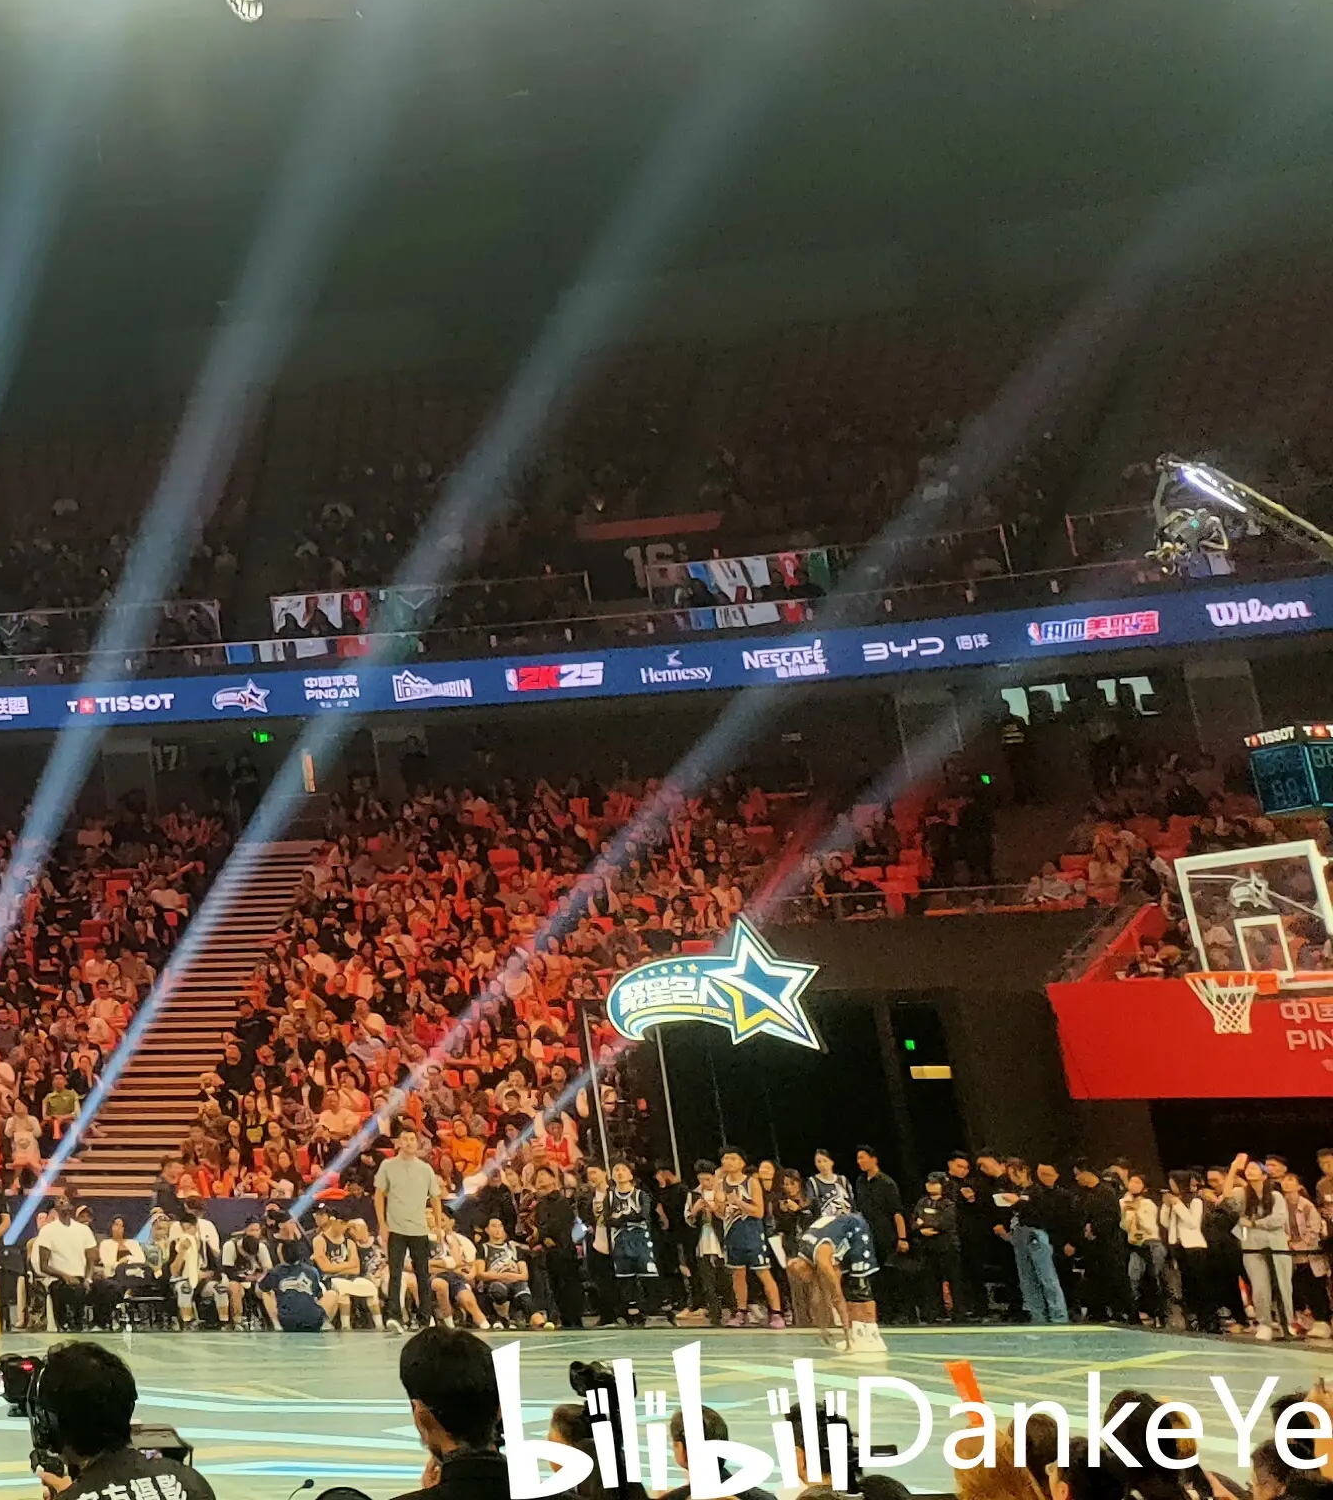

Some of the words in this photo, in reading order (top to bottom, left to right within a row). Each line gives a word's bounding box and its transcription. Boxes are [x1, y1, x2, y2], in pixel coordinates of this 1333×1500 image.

[1206, 598, 1311, 627] Wilson
[742, 638, 827, 670] NESCAFÉ
[862, 636, 944, 662] BYD
[303, 675, 359, 688] 中国平安
[640, 665, 713, 683] Hennessy
[95, 693, 175, 713] TISSOT
[619, 975, 730, 1016] 聚星名人
